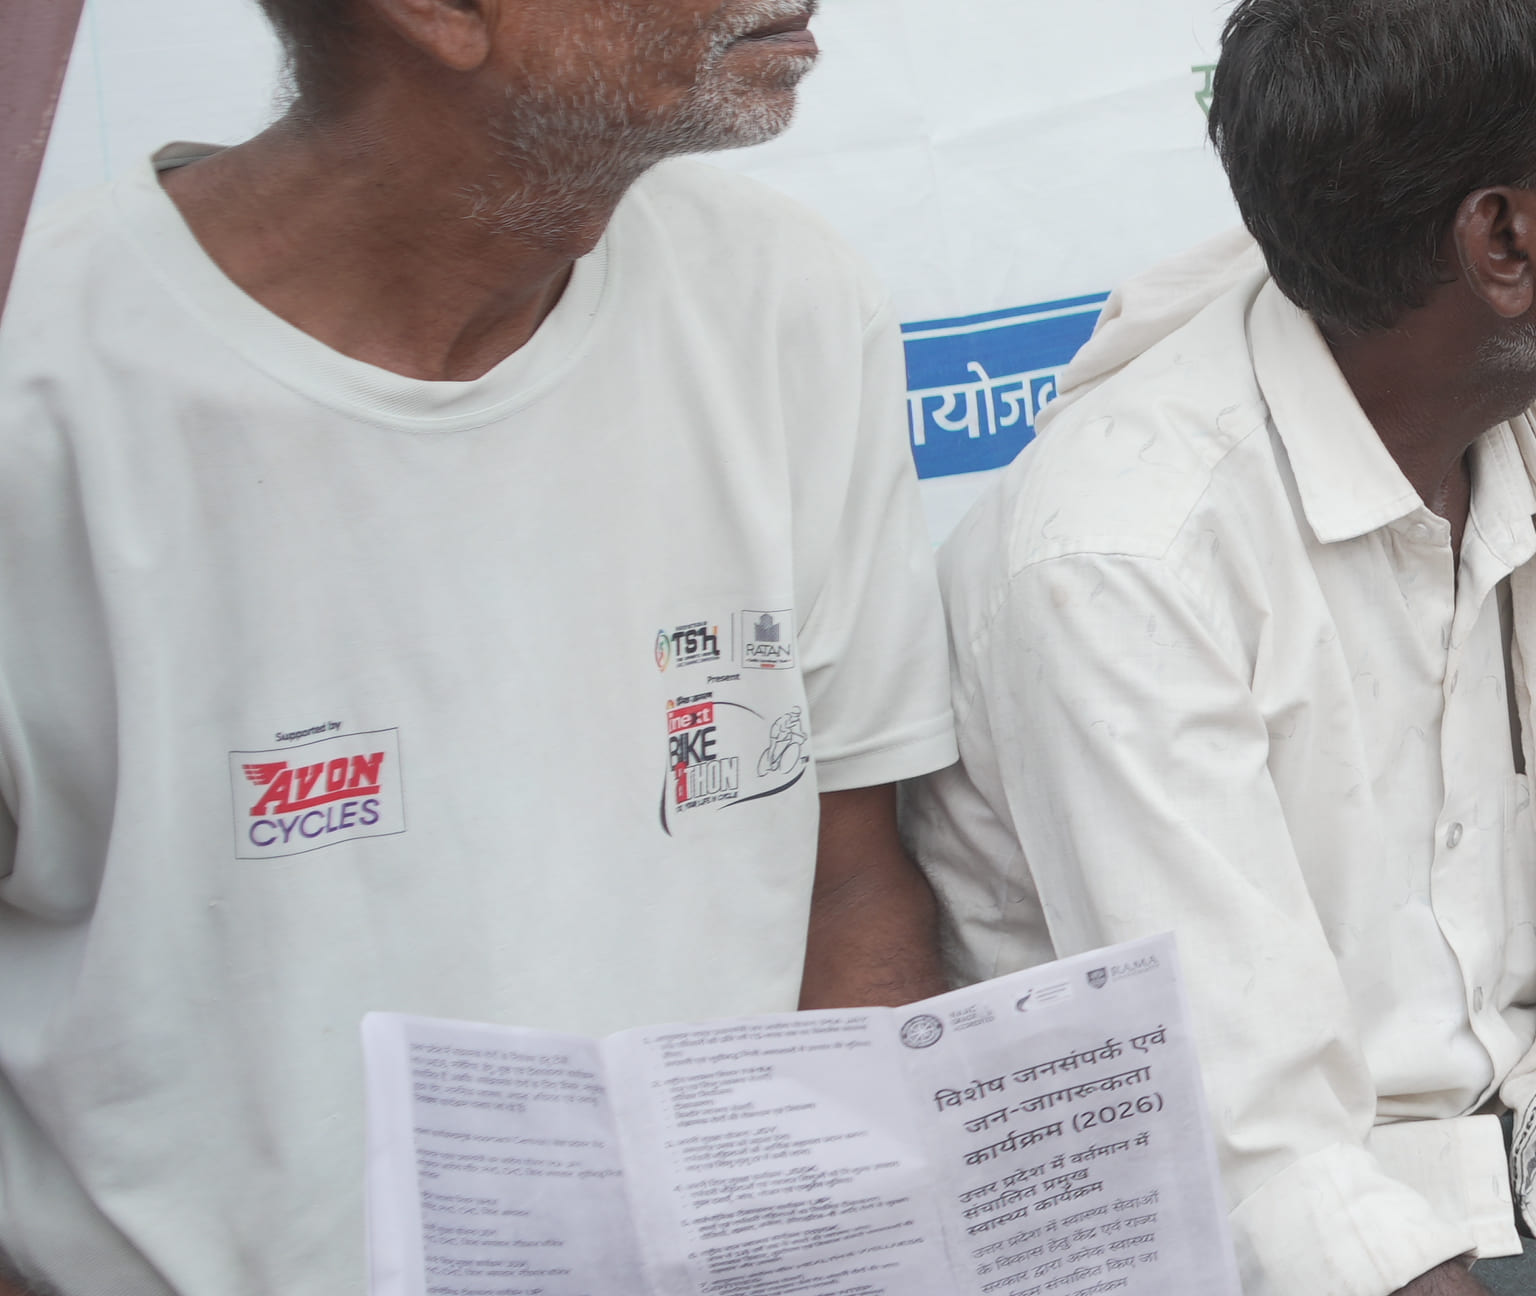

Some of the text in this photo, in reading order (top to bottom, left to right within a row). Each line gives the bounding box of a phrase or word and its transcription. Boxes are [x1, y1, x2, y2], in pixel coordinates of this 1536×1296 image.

[746, 644, 791, 657] RATAN
[275, 720, 342, 743] Supported by
[669, 725, 717, 772] BIKE
[248, 751, 385, 817] AVON
[249, 798, 381, 847] CYCLES
[934, 1024, 1168, 1112] विशेष जनसंपर्क एवं
[963, 1065, 1152, 1134] जन-जागरूकता
[963, 1092, 1165, 1167] कार्यक्रम (2026)
[958, 1131, 1151, 1204] उत्तर प्रदेश में वर्तमान में
[961, 1167, 1090, 1220] संचालित प्रमुख
[965, 1181, 1104, 1236] स्वास्थ्य कार्यक्रम
